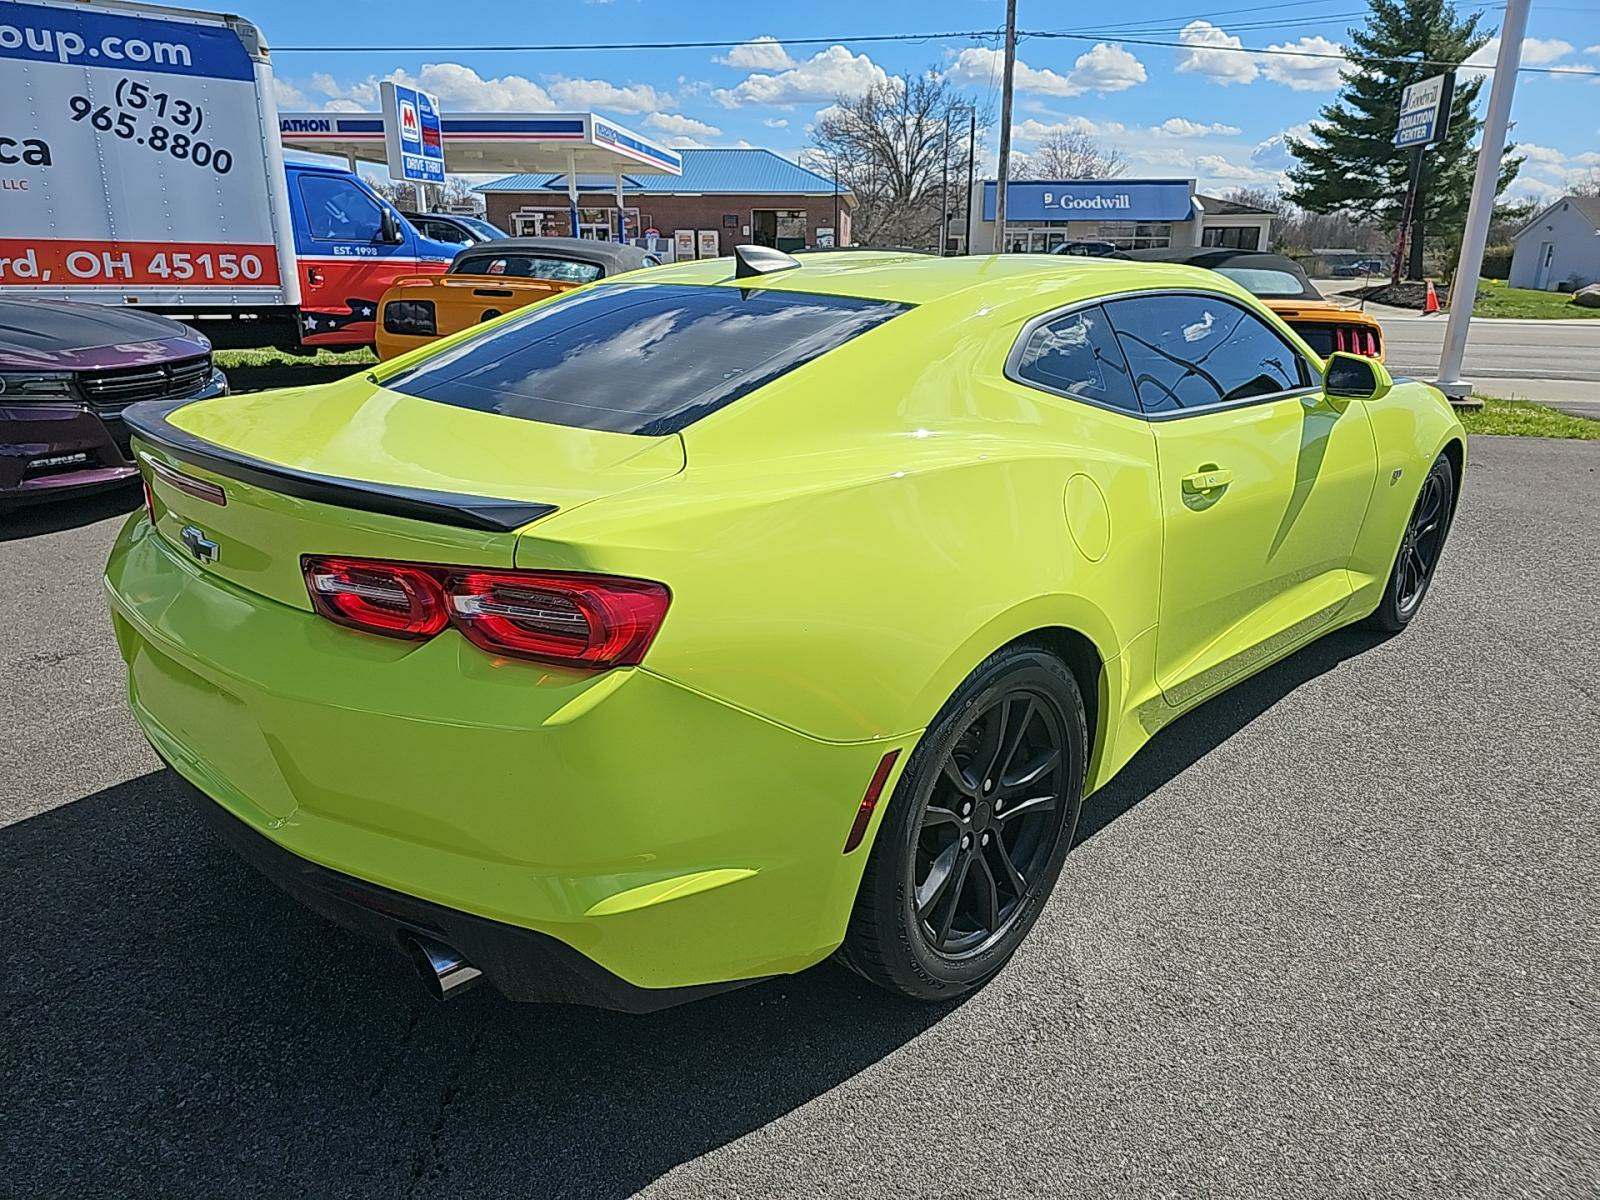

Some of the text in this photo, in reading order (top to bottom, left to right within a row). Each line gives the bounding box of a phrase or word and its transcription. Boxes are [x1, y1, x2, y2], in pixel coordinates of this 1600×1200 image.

[115, 78, 203, 135] (513)
[69, 95, 233, 175] 965.8800
[406, 157, 441, 174] DRIVE THRU
[2, 179, 29, 190] LLC
[1060, 194, 1131, 209] Goodwill
[333, 246, 378, 256] EST. 1998
[66, 250, 133, 279] OH
[147, 253, 263, 279] 45150
